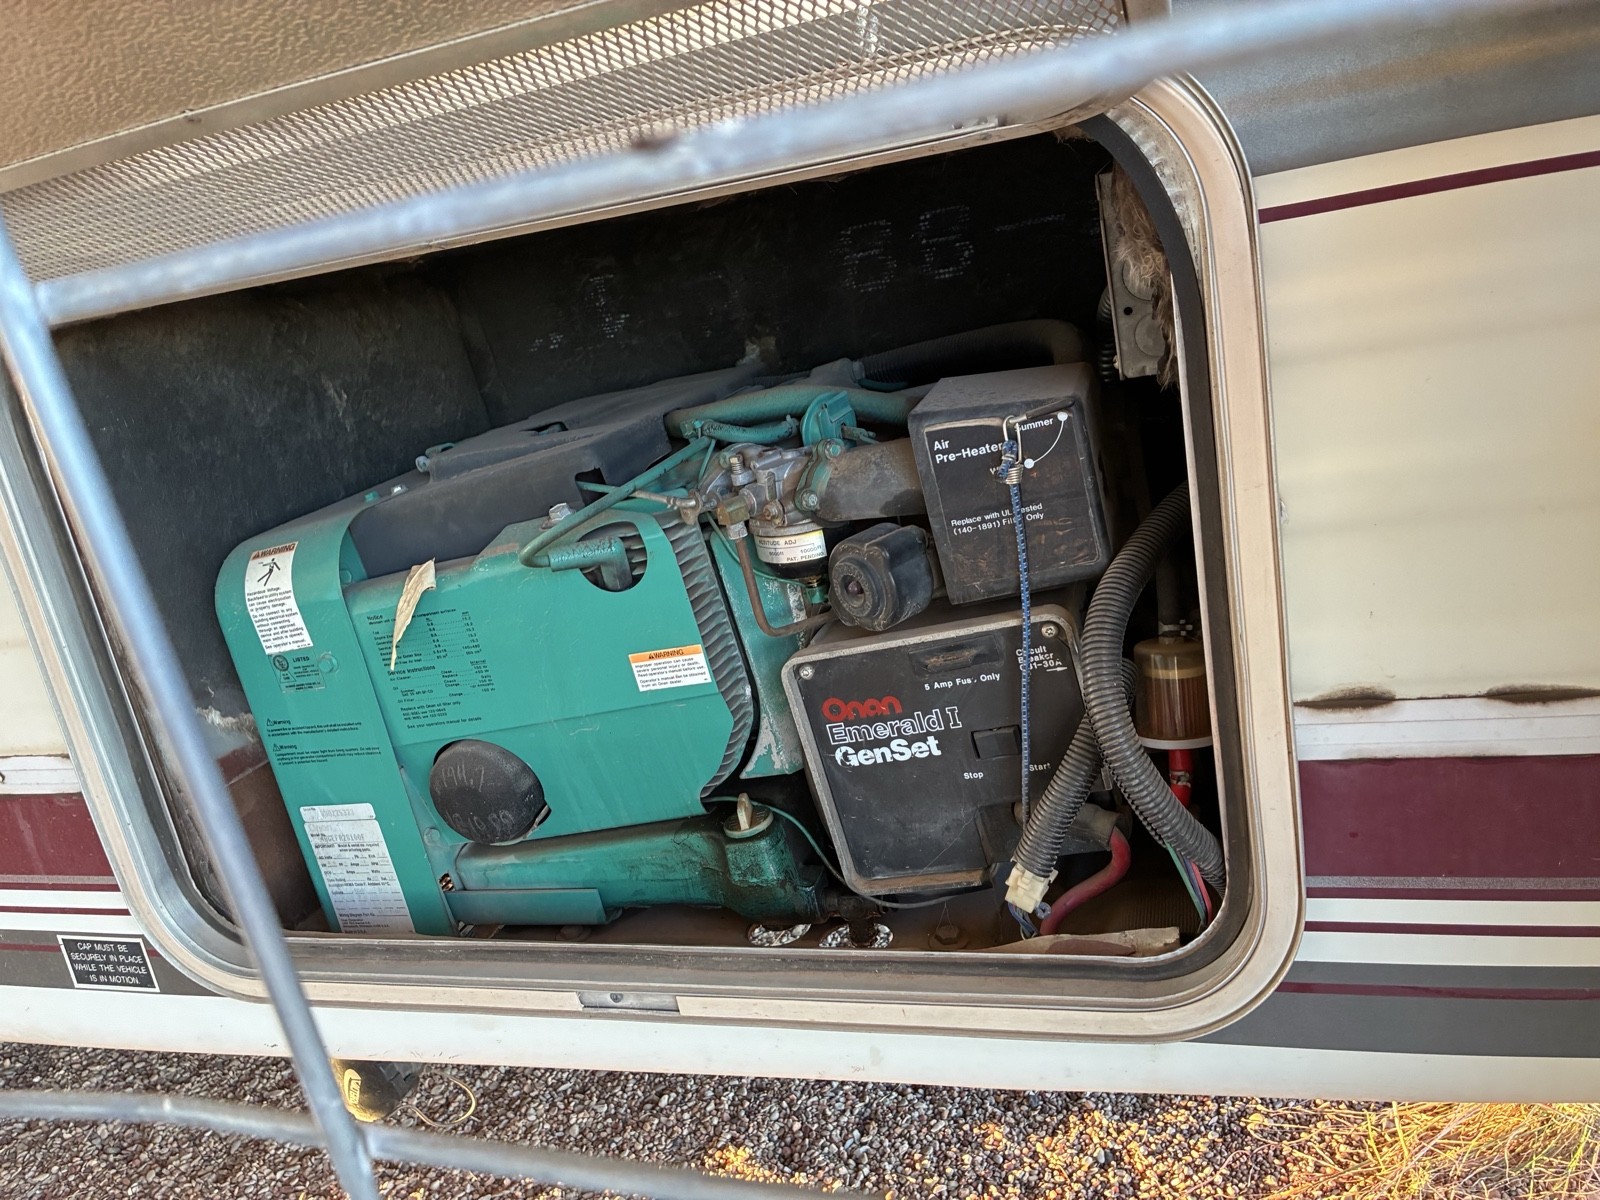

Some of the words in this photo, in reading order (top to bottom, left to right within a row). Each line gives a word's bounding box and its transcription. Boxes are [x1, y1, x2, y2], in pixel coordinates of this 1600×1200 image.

[1015, 418, 1054, 432] Summer
[934, 440, 950, 452] Air
[935, 442, 1004, 464] Pre-Heater
[951, 516, 982, 527] Replace
[984, 512, 1000, 520] with
[1020, 502, 1044, 513] ested
[954, 520, 1001, 536] (140-1891)
[1026, 512, 1044, 522] Only
[260, 543, 296, 557] WARNING
[800, 551, 825, 560] PENDING
[654, 649, 684, 659] WARNING
[1016, 646, 1047, 656] Ccuit
[1018, 652, 1054, 664] Beaker
[980, 672, 1000, 682] Only
[821, 695, 902, 722] Onan
[826, 708, 944, 745] Emerald
[945, 706, 962, 728] I
[834, 735, 942, 768] GenSet
[1028, 762, 1052, 772] Start
[963, 771, 984, 780] Stop
[94, 943, 114, 952] MUST
[70, 952, 107, 963] SECURELY
[120, 955, 144, 964] PLACE
[73, 963, 97, 972] WHILE
[117, 966, 148, 974] VEHICLE
[109, 975, 141, 985] MOTION.
